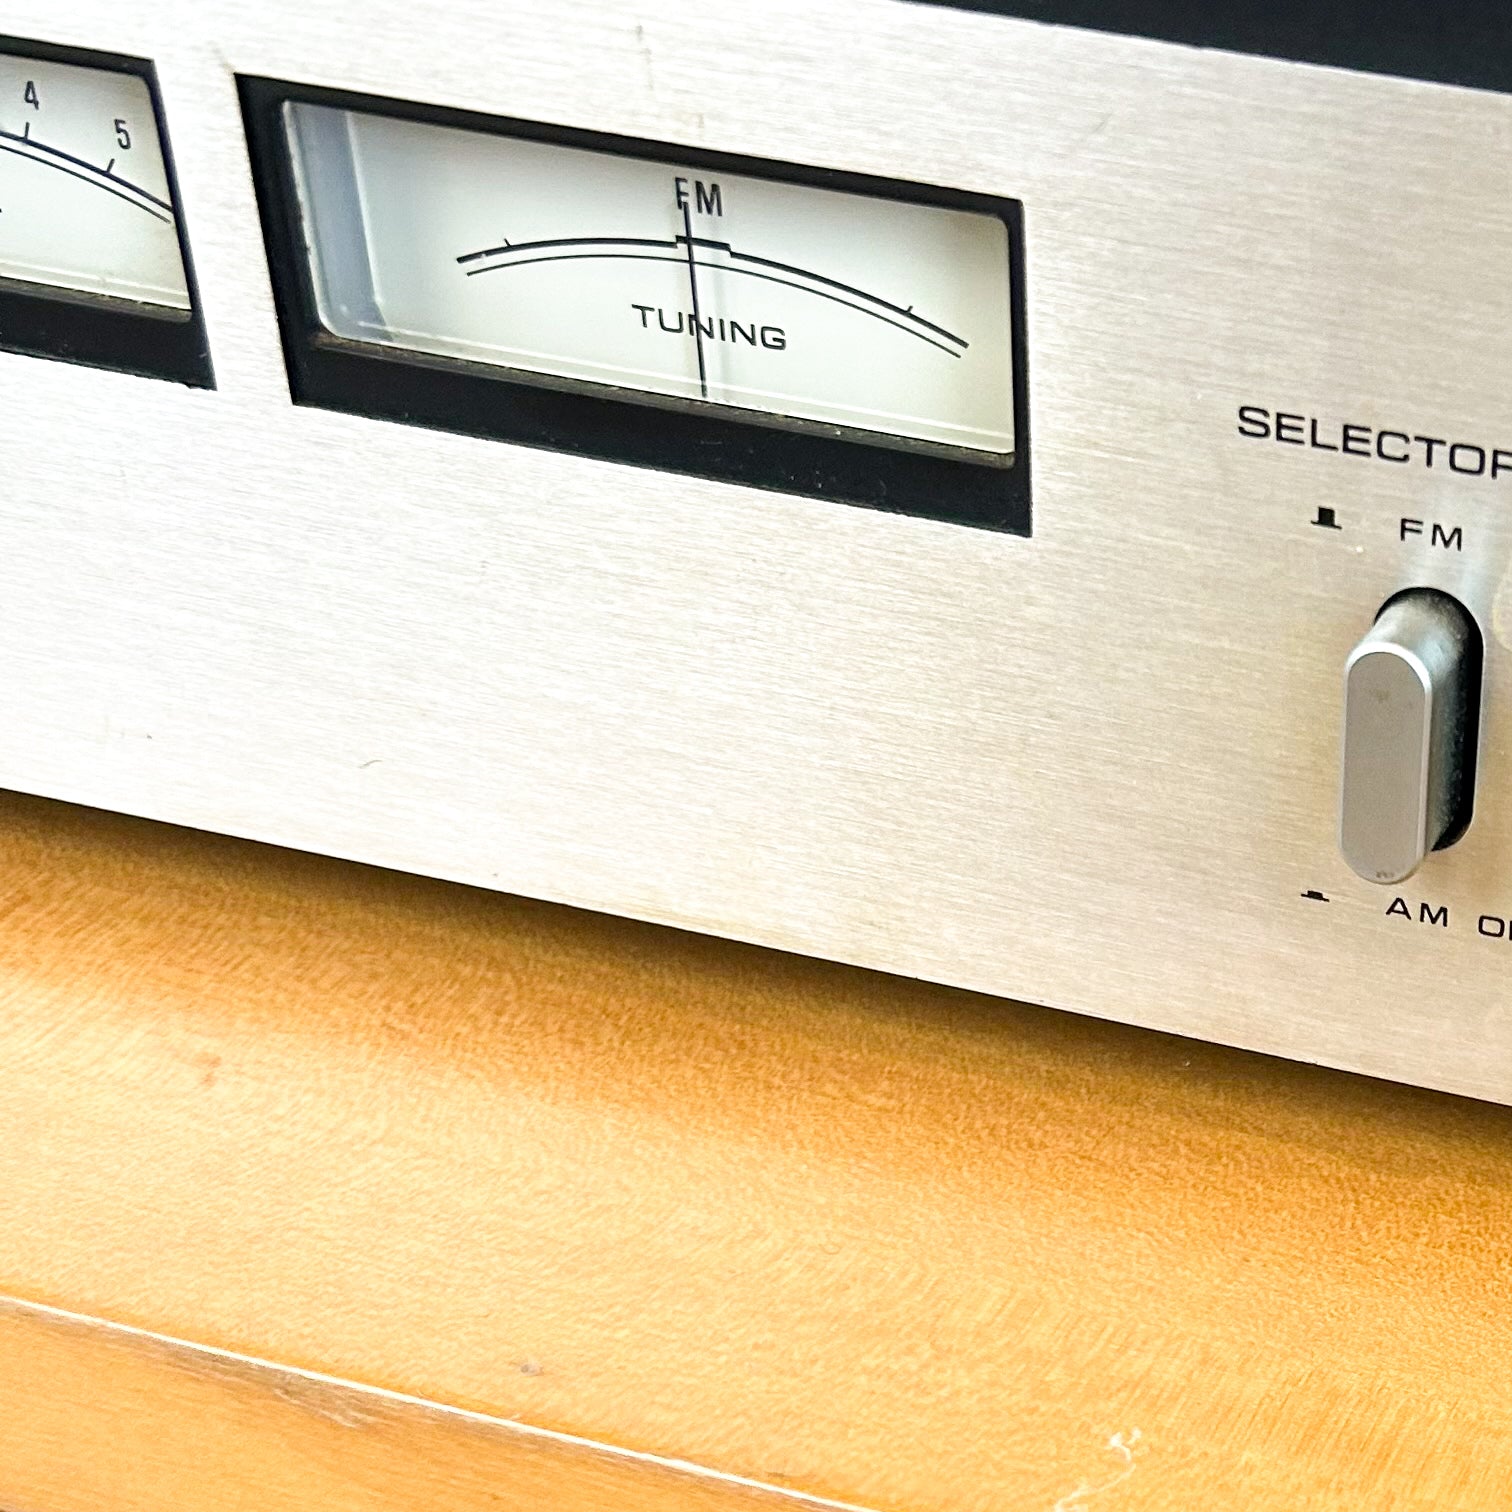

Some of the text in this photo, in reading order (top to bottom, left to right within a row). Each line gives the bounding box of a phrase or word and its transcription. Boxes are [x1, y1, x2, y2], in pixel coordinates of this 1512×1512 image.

[23, 79, 41, 111] 4
[113, 117, 132, 151] 5
[674, 176, 724, 217] FM
[631, 303, 788, 351] TUNING
[1398, 516, 1464, 553] FM
[1384, 895, 1450, 929] AM
